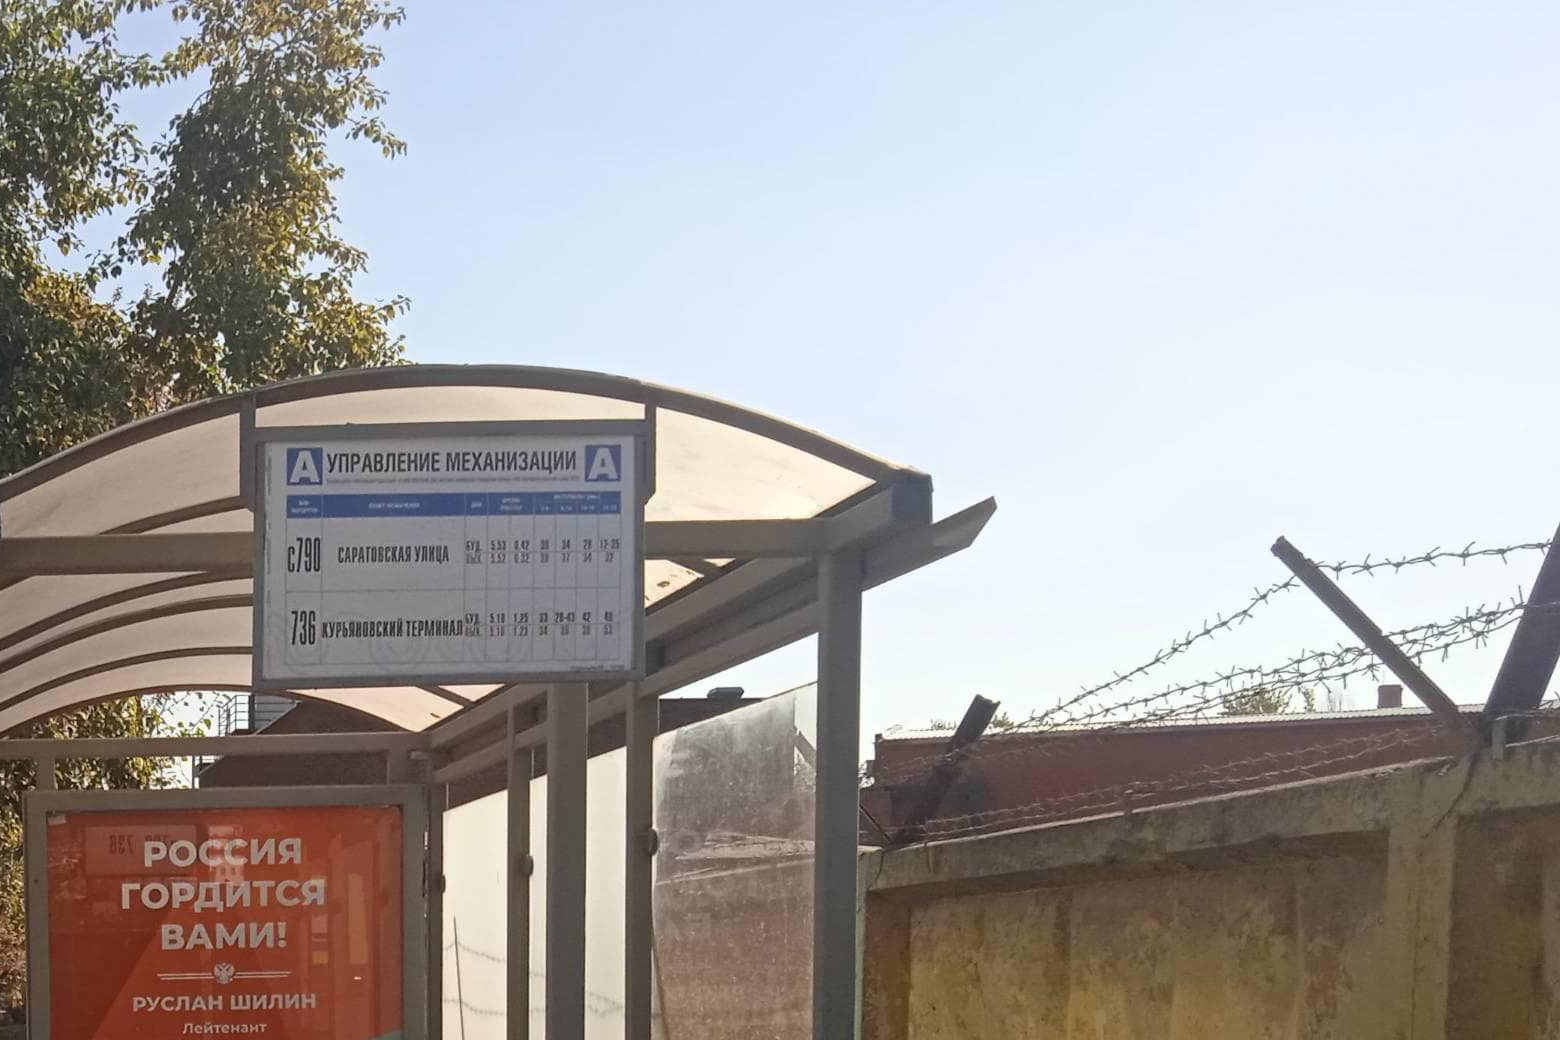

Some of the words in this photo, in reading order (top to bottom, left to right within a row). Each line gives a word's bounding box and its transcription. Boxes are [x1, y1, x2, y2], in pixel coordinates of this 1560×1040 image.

[289, 449, 321, 484] А
[326, 452, 441, 473] УПРАВЛЕНИЕ
[445, 450, 577, 474] МЕХАНИЗАЦИИ
[587, 447, 619, 480] А
[337, 545, 412, 564] САРАТОВСКАЯ
[414, 545, 449, 565] УЛИЦА
[291, 610, 316, 646] 736
[321, 618, 404, 639] КУРЬЯНОВСКИЙ
[406, 620, 463, 638] ТЕРМИНАЛ
[143, 838, 302, 868] РОССИЯ
[121, 879, 326, 913] ГОРДИТСЯ
[161, 922, 288, 950] ВАМИ!
[132, 996, 224, 1012] РУСЛАН
[230, 993, 317, 1010] ШИЛИН
[182, 1022, 268, 1034] Лейтенант
